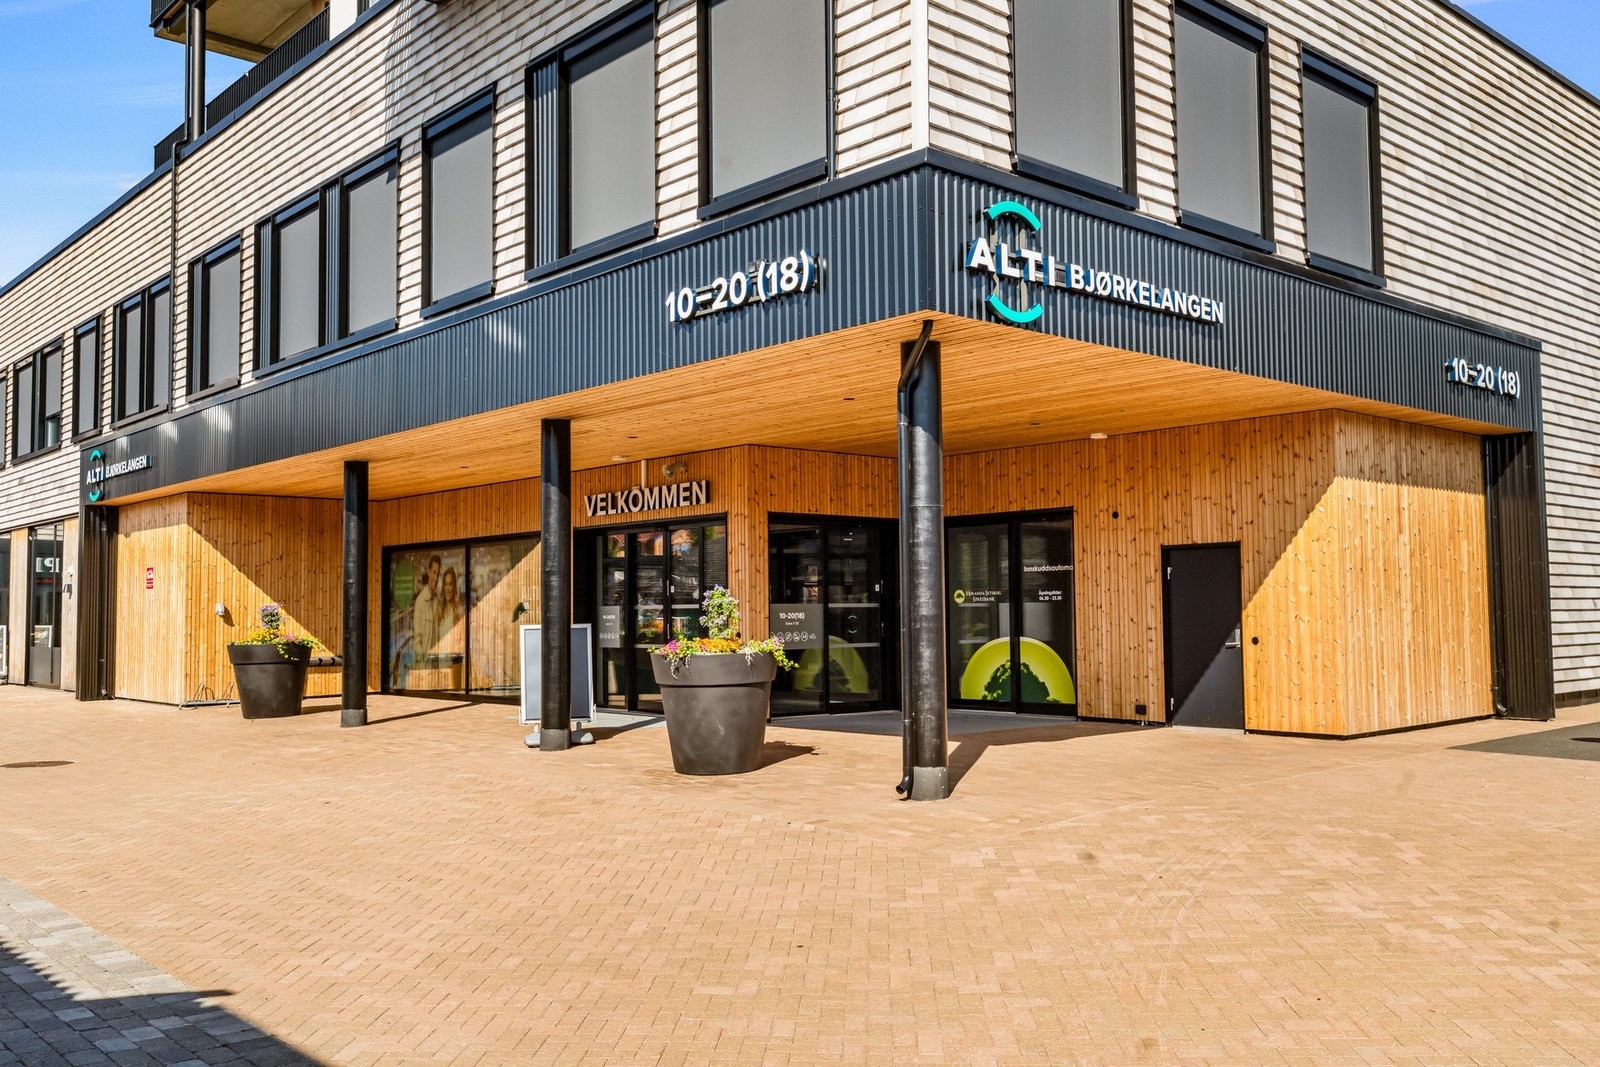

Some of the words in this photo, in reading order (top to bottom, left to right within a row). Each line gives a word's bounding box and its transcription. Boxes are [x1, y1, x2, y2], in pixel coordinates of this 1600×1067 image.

[665, 271, 747, 323] 10-20
[757, 249, 810, 303] (18)
[969, 237, 1056, 287] ALTI
[1069, 263, 1224, 324] BJØRKELANGEN
[1498, 366, 1520, 400] (18)
[86, 466, 104, 485] ALTI
[584, 480, 707, 517] VELKOMMEN
